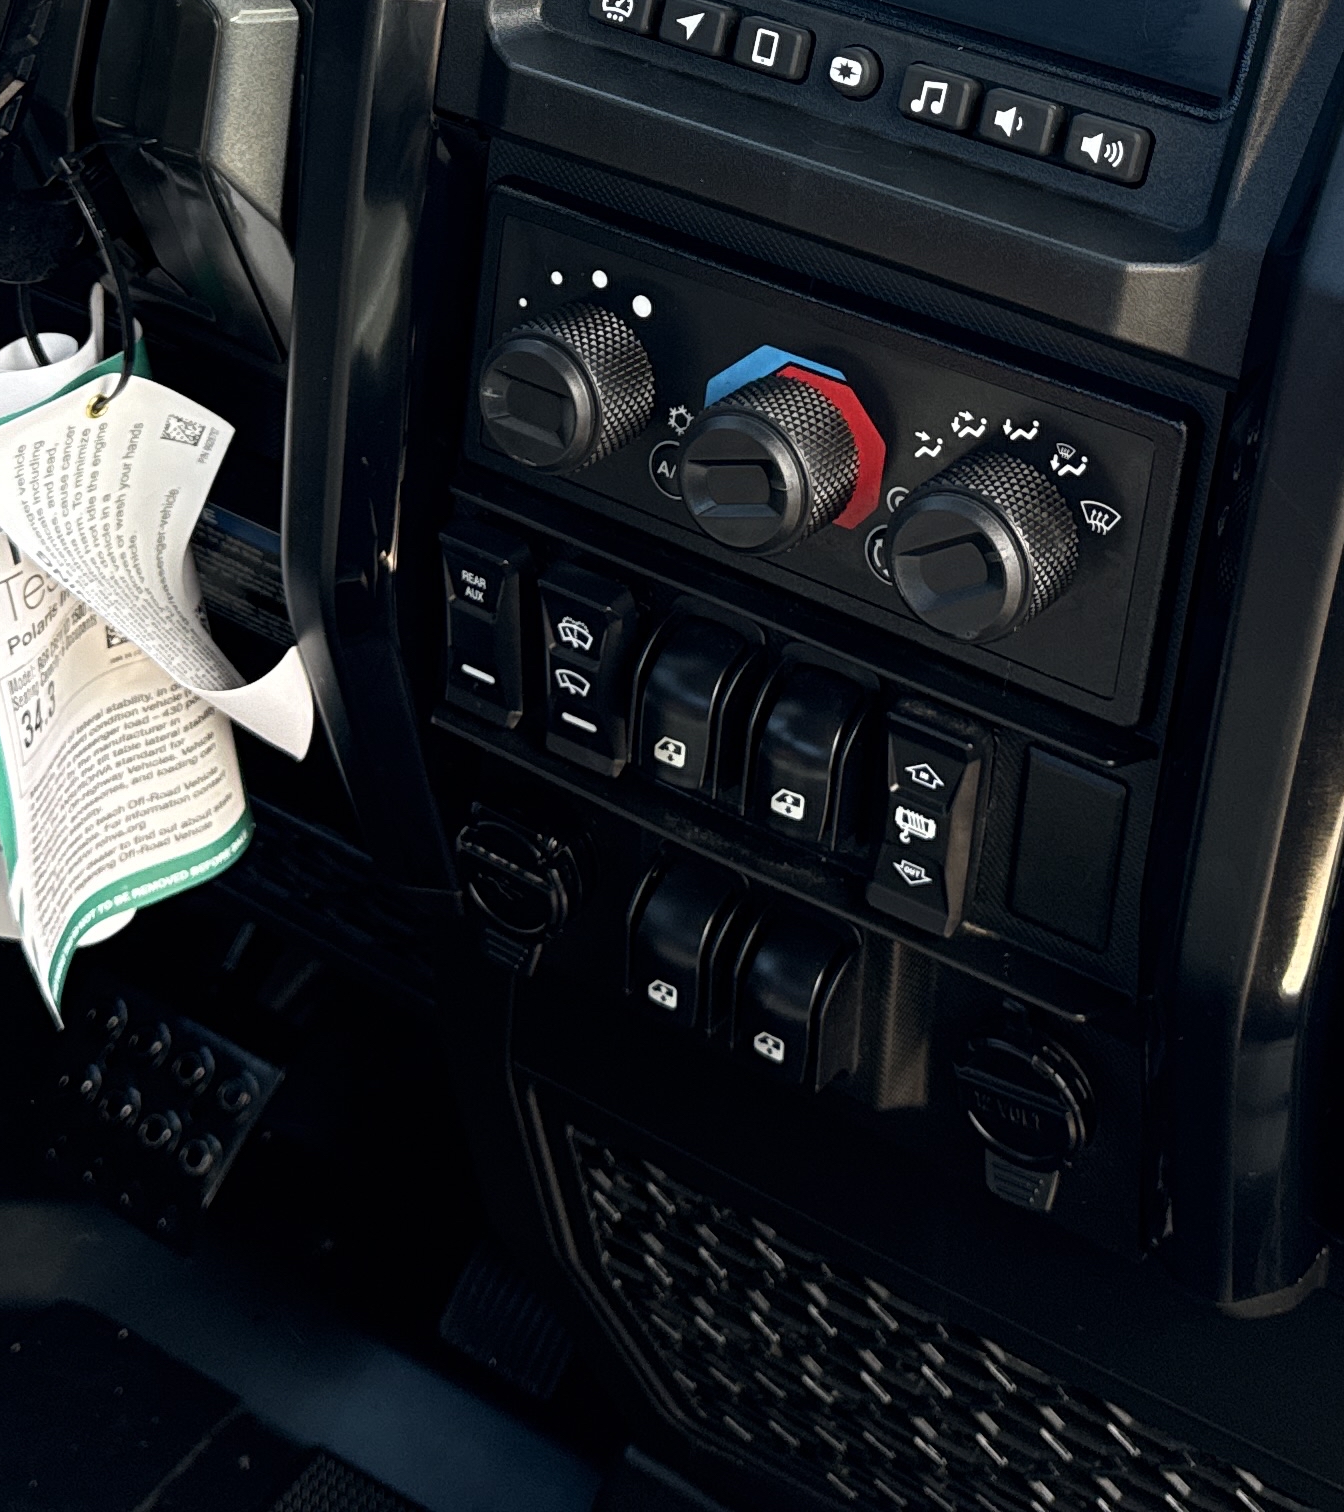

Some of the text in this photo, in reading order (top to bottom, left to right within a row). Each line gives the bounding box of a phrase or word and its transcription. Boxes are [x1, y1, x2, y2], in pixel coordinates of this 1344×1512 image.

[60, 425, 76, 471] cancer
[73, 428, 91, 488] minimize
[92, 422, 108, 466] engine
[122, 422, 144, 459] hands
[14, 444, 26, 495] vehicle
[29, 440, 45, 505] including
[86, 470, 100, 493] the
[118, 463, 133, 491] your
[657, 460, 677, 480] A/
[43, 481, 55, 509] and
[60, 474, 70, 517] cause
[72, 491, 82, 510] To
[114, 493, 127, 531] wash
[461, 569, 487, 590] REAR
[464, 586, 485, 603] AUX
[7, 602, 58, 656] Polaris
[21, 680, 56, 749] 34.3
[128, 786, 180, 808] Off-Road
[132, 869, 189, 900] REMOVED
